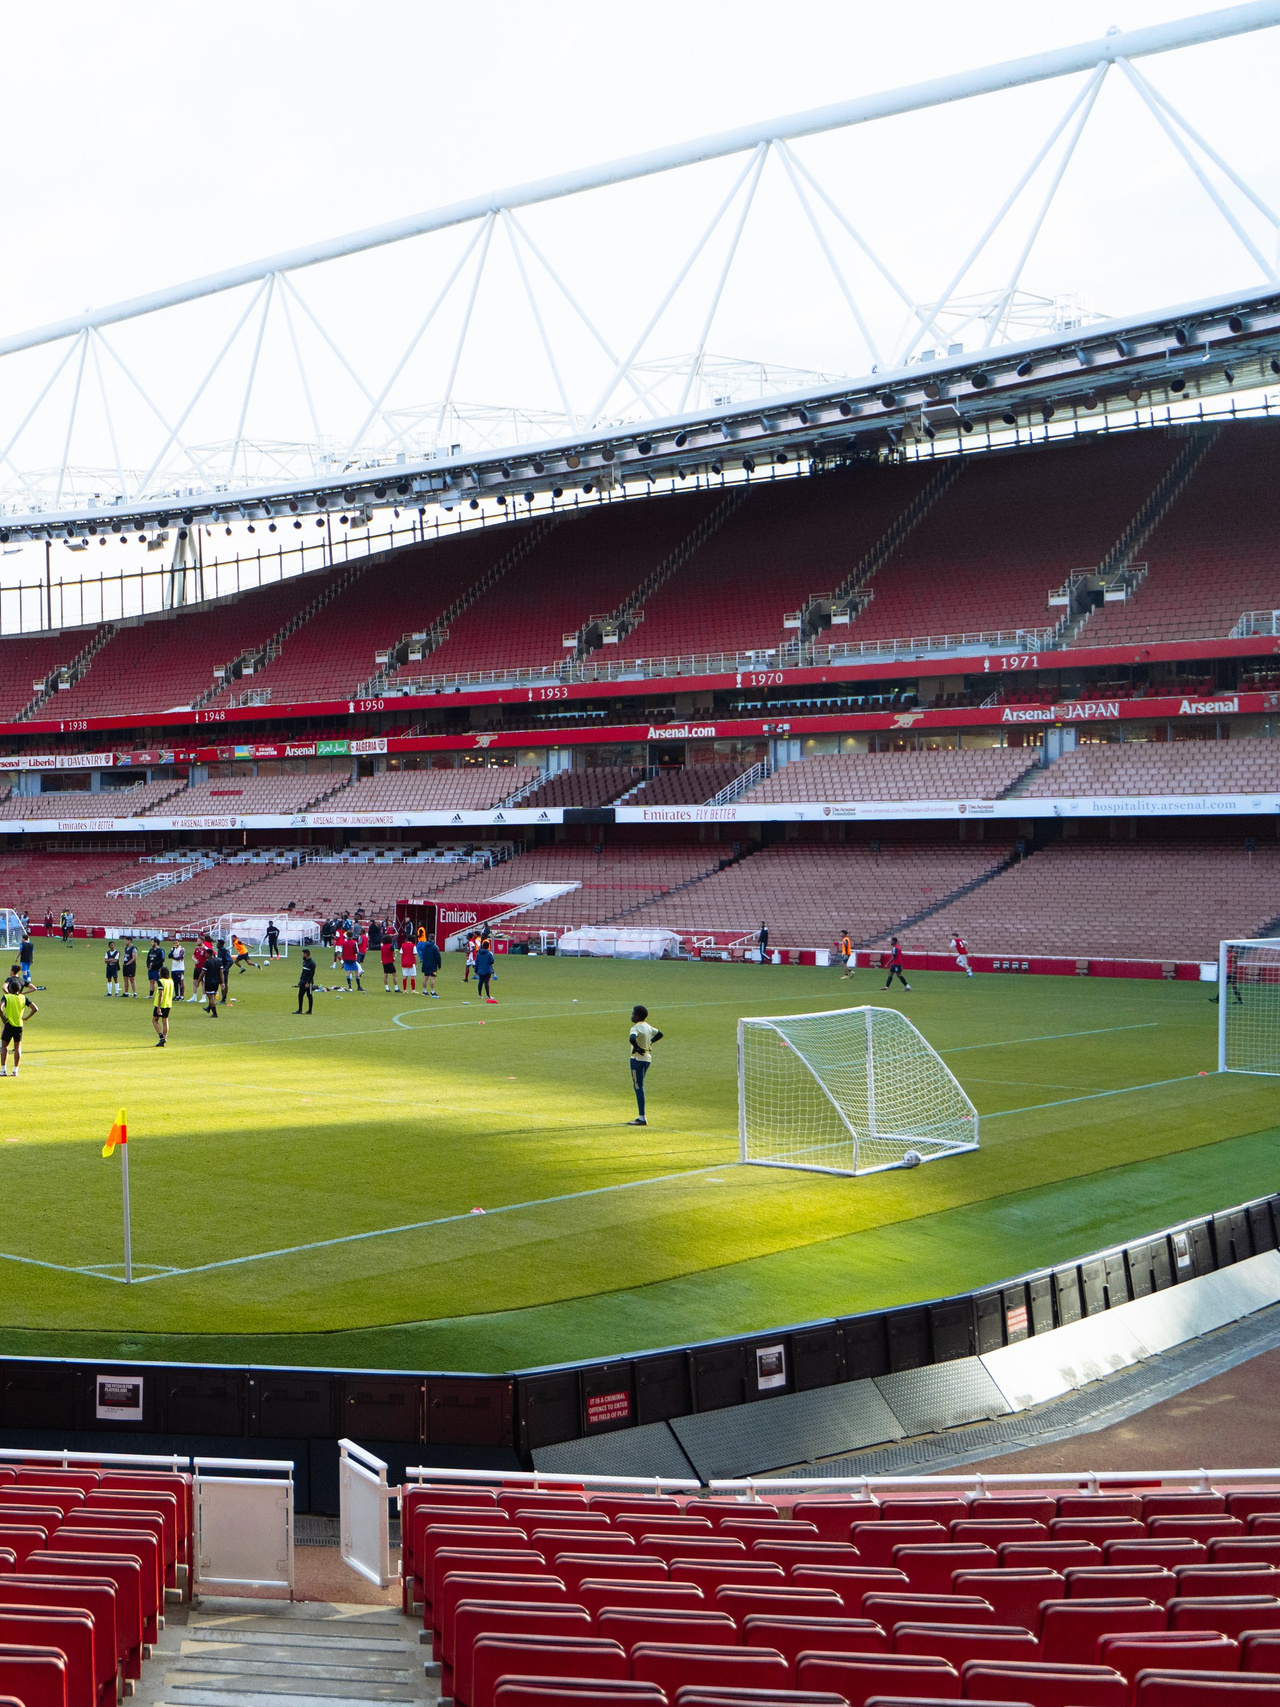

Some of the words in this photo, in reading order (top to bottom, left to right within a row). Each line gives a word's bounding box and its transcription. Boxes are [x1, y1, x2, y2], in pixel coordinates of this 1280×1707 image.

[1000, 656, 1039, 670] 1971
[750, 672, 784, 686] 1970
[540, 687, 568, 700] 1953
[360, 700, 384, 711] 1950
[1178, 698, 1239, 714] Arsenal
[204, 712, 226, 721] 1948
[1001, 706, 1056, 722] Arsenal
[1064, 702, 1120, 719] JAPAN
[68, 721, 88, 730] 1938
[647, 725, 716, 739] Arsenal.com
[284, 746, 316, 756] Arsenal
[356, 742, 377, 752] ALGERIA
[28, 758, 55, 767] Liberia
[68, 756, 102, 767] DAVENTRY
[1092, 799, 1236, 815] hospitality.arsenal.com
[642, 809, 692, 820] Emirates
[696, 808, 708, 820] FLY
[710, 808, 736, 820] BETTER
[58, 822, 88, 831] Emirates
[90, 822, 98, 830] FLY
[98, 821, 114, 830] BETTER
[172, 820, 179, 828] MY
[181, 819, 202, 828] ARSENAL
[204, 818, 228, 827] REWARDS
[312, 816, 394, 825] ARSENAL.COM/JUNIORGUNNERS
[440, 908, 477, 924] Emirates
[604, 1393, 626, 1402] CRIMINAL
[599, 1412, 610, 1421] FIELD
